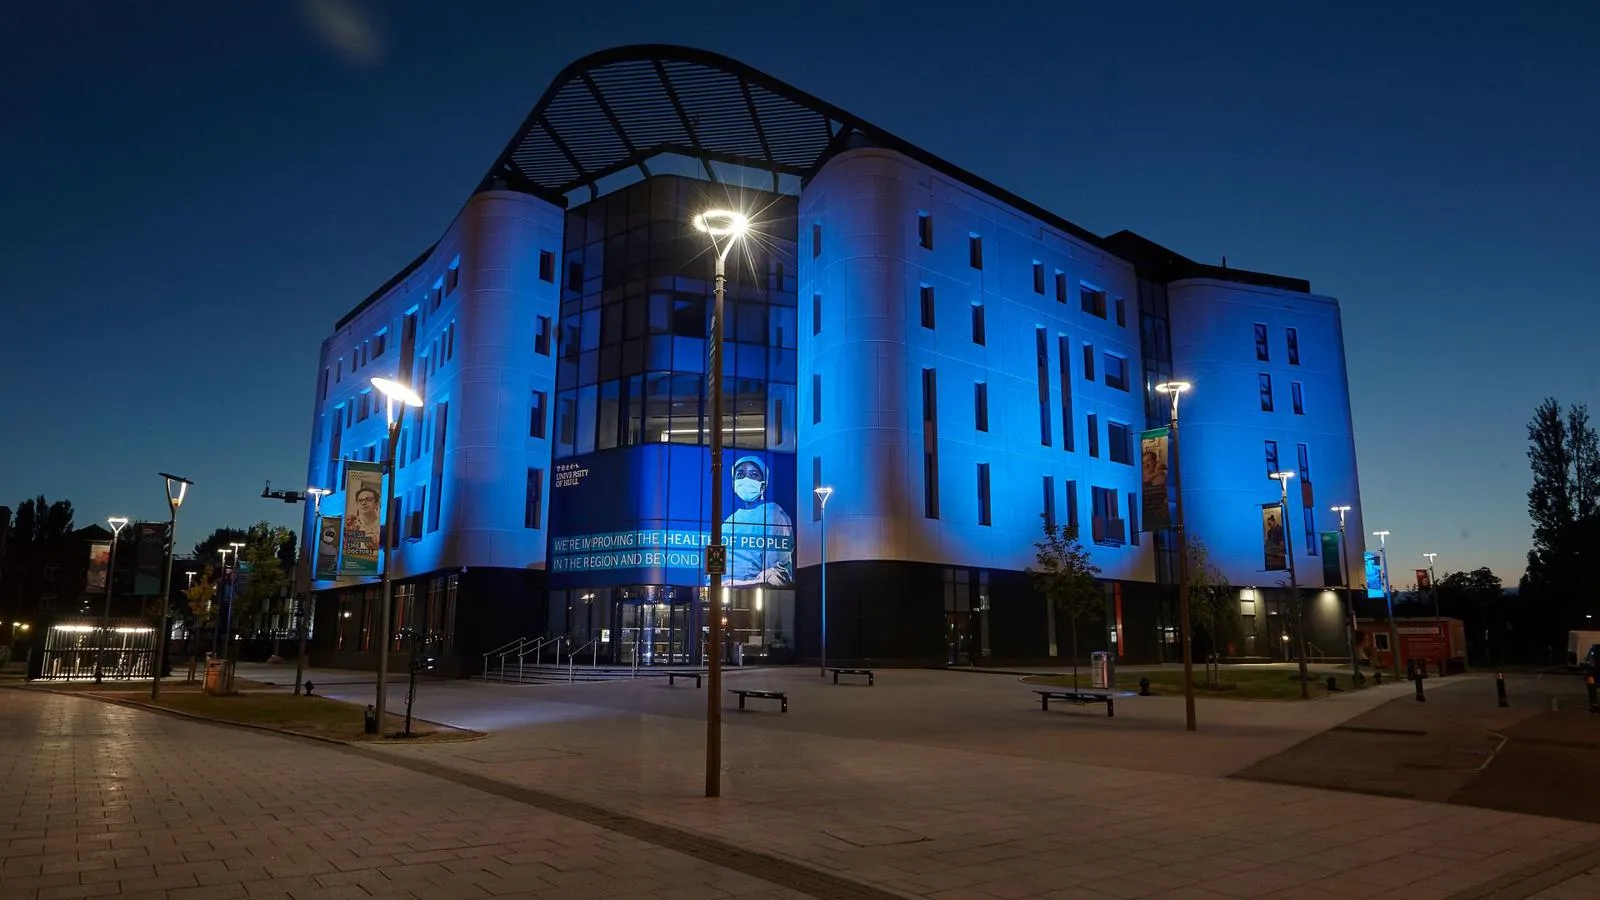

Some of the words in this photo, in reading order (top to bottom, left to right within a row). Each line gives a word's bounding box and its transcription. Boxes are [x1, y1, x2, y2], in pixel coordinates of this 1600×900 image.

[555, 468, 589, 480] UNIVERSITY
[555, 480, 563, 488] OF
[563, 477, 579, 487] HULL
[554, 539, 580, 551] WE'RE
[582, 534, 633, 549] IMPROVING
[637, 532, 659, 545] THE
[721, 536, 737, 546] OF
[741, 536, 788, 549] PEOPLE
[553, 559, 562, 569] IN
[564, 557, 581, 569] THE
[583, 555, 618, 568] REGION
[620, 553, 642, 566] AND
[645, 553, 699, 566] BEYOND
